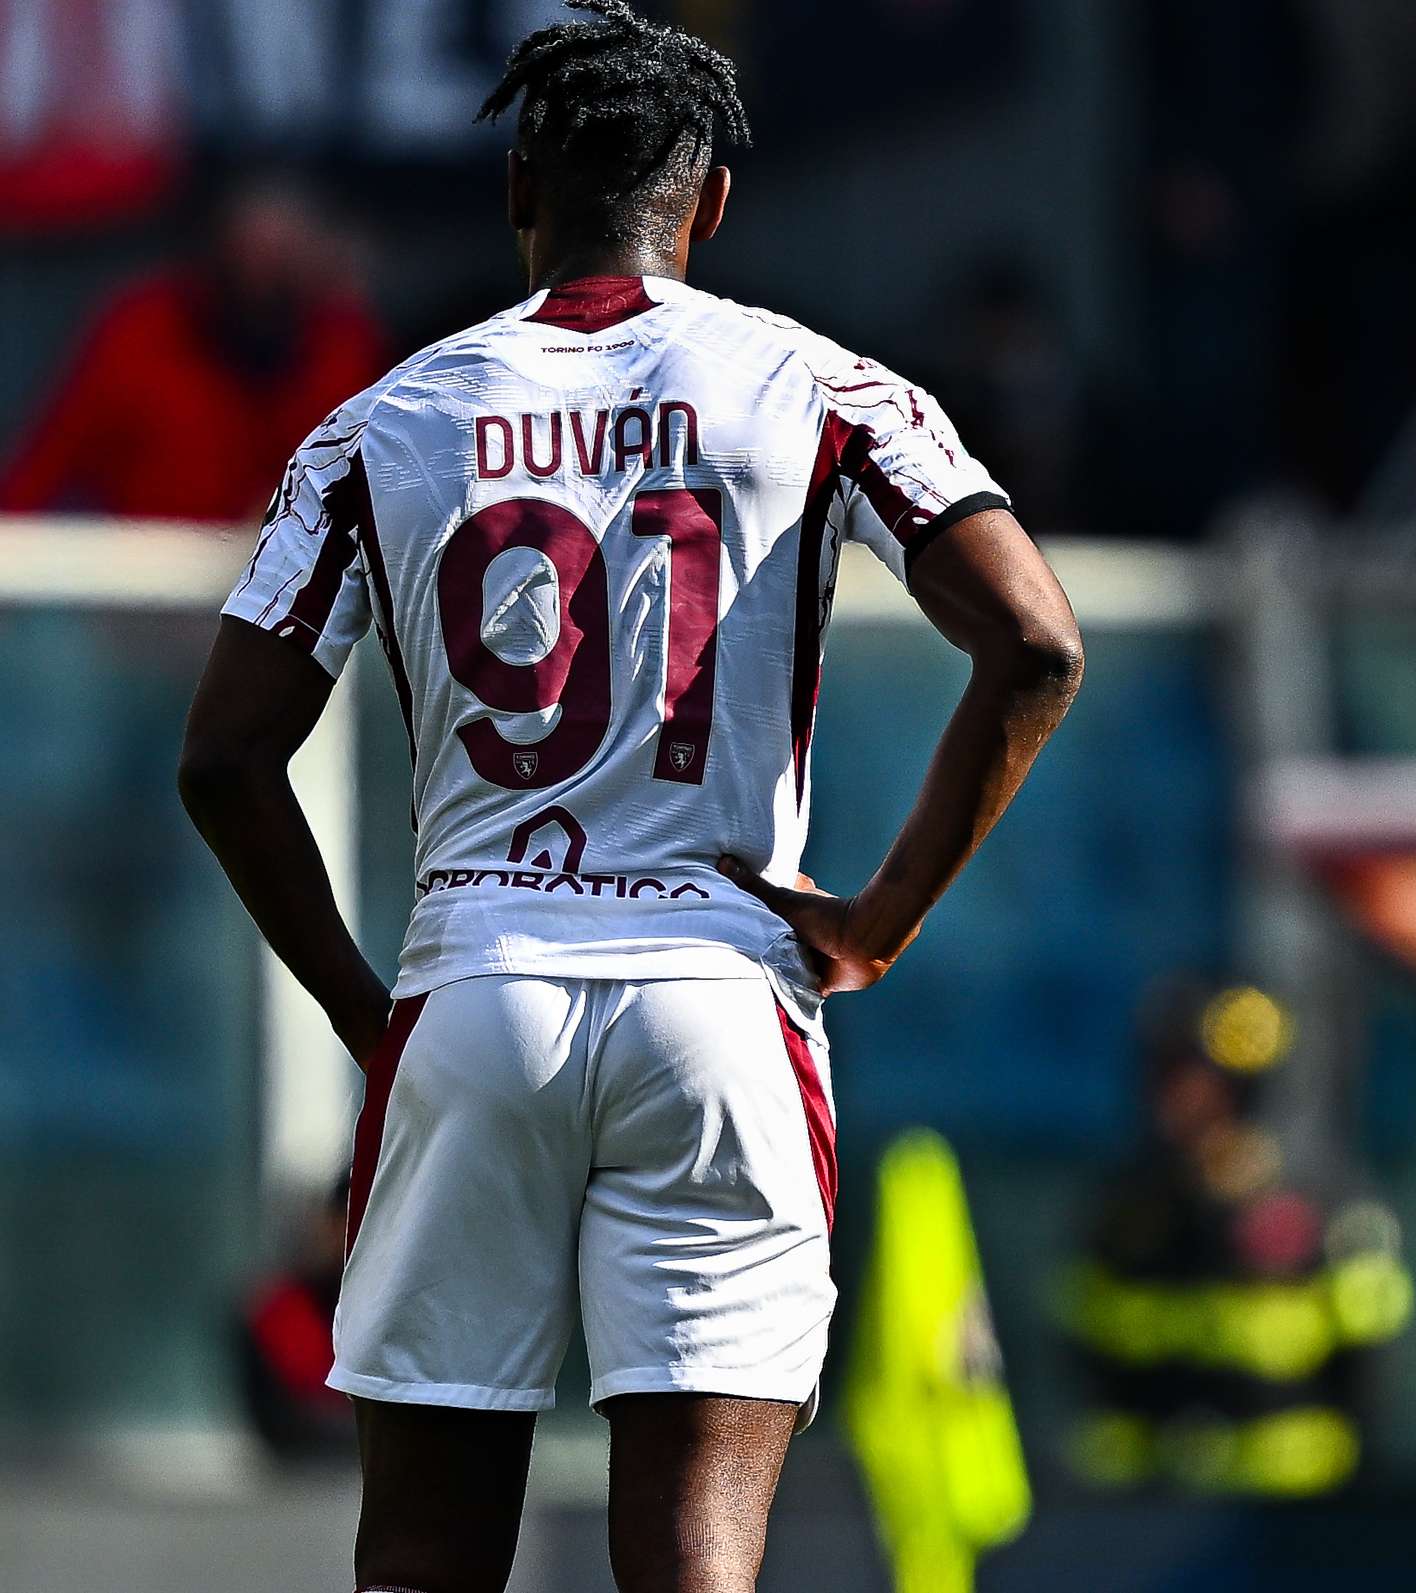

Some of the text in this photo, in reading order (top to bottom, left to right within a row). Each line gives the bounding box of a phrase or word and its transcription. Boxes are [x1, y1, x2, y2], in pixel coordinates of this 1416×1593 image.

[605, 339, 635, 351] 1900
[474, 386, 699, 480] DUVÁN
[436, 487, 723, 791] 91
